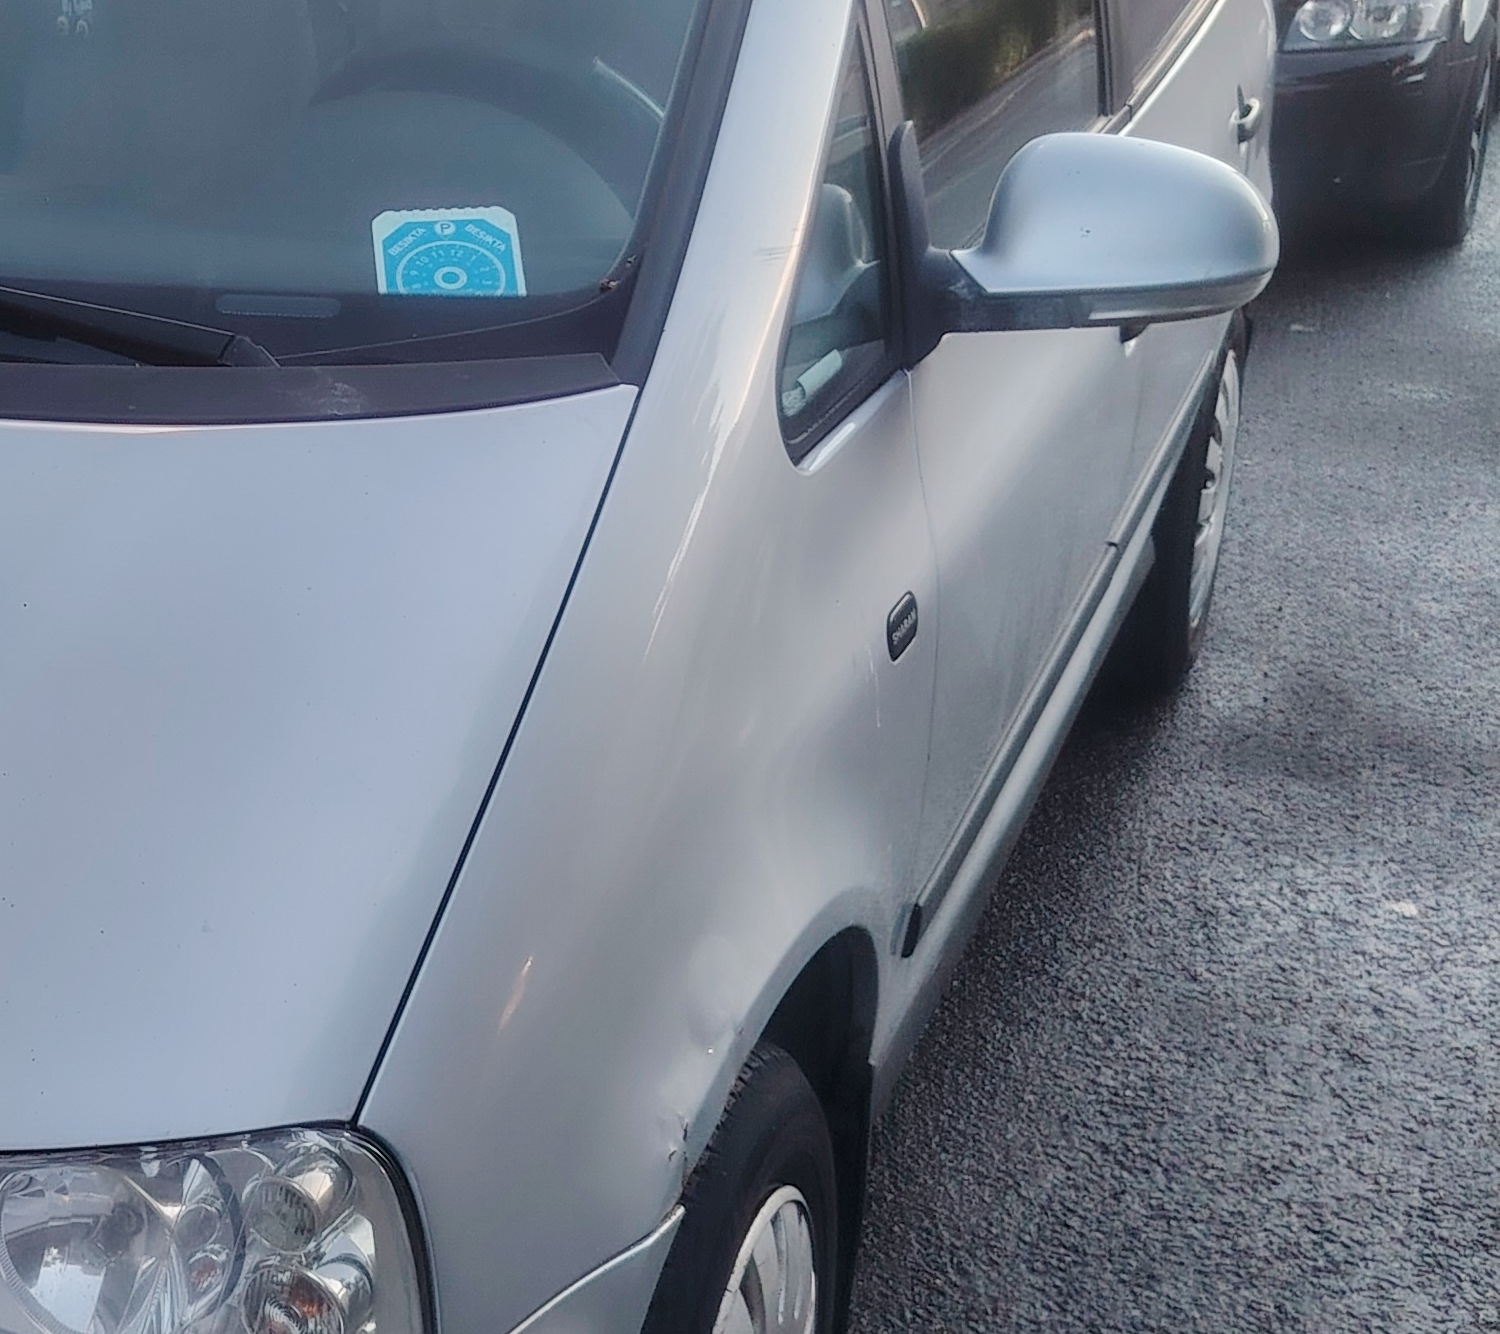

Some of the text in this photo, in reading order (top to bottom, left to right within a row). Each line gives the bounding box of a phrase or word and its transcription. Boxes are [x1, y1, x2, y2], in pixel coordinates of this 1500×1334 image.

[387, 227, 426, 256] BESIKTA
[439, 223, 451, 234] P
[465, 223, 506, 252] BESIKTA
